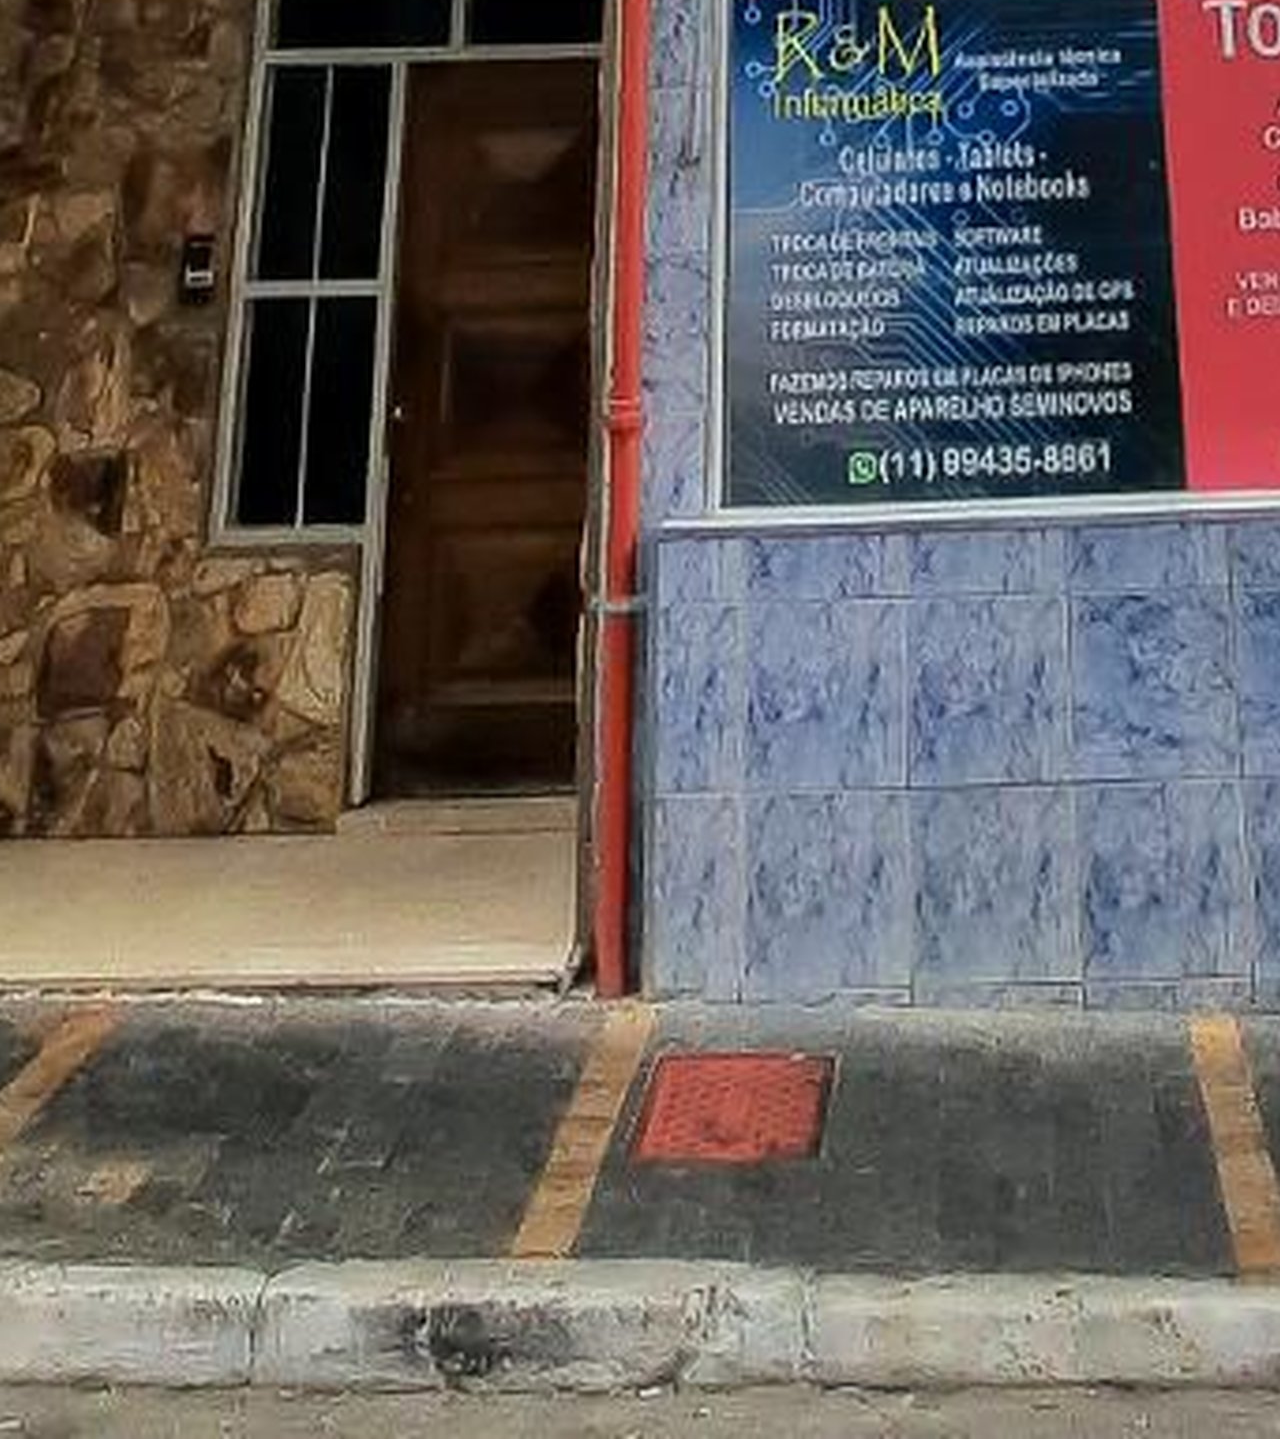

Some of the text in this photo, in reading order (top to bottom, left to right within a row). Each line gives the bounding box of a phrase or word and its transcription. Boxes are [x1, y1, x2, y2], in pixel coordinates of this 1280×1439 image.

[838, 145, 940, 174] Celulares
[976, 173, 1091, 201] Notebooks
[773, 387, 1133, 425] VENDAS DE APARELHO SEMINOVOS
[878, 448, 935, 484] (11)
